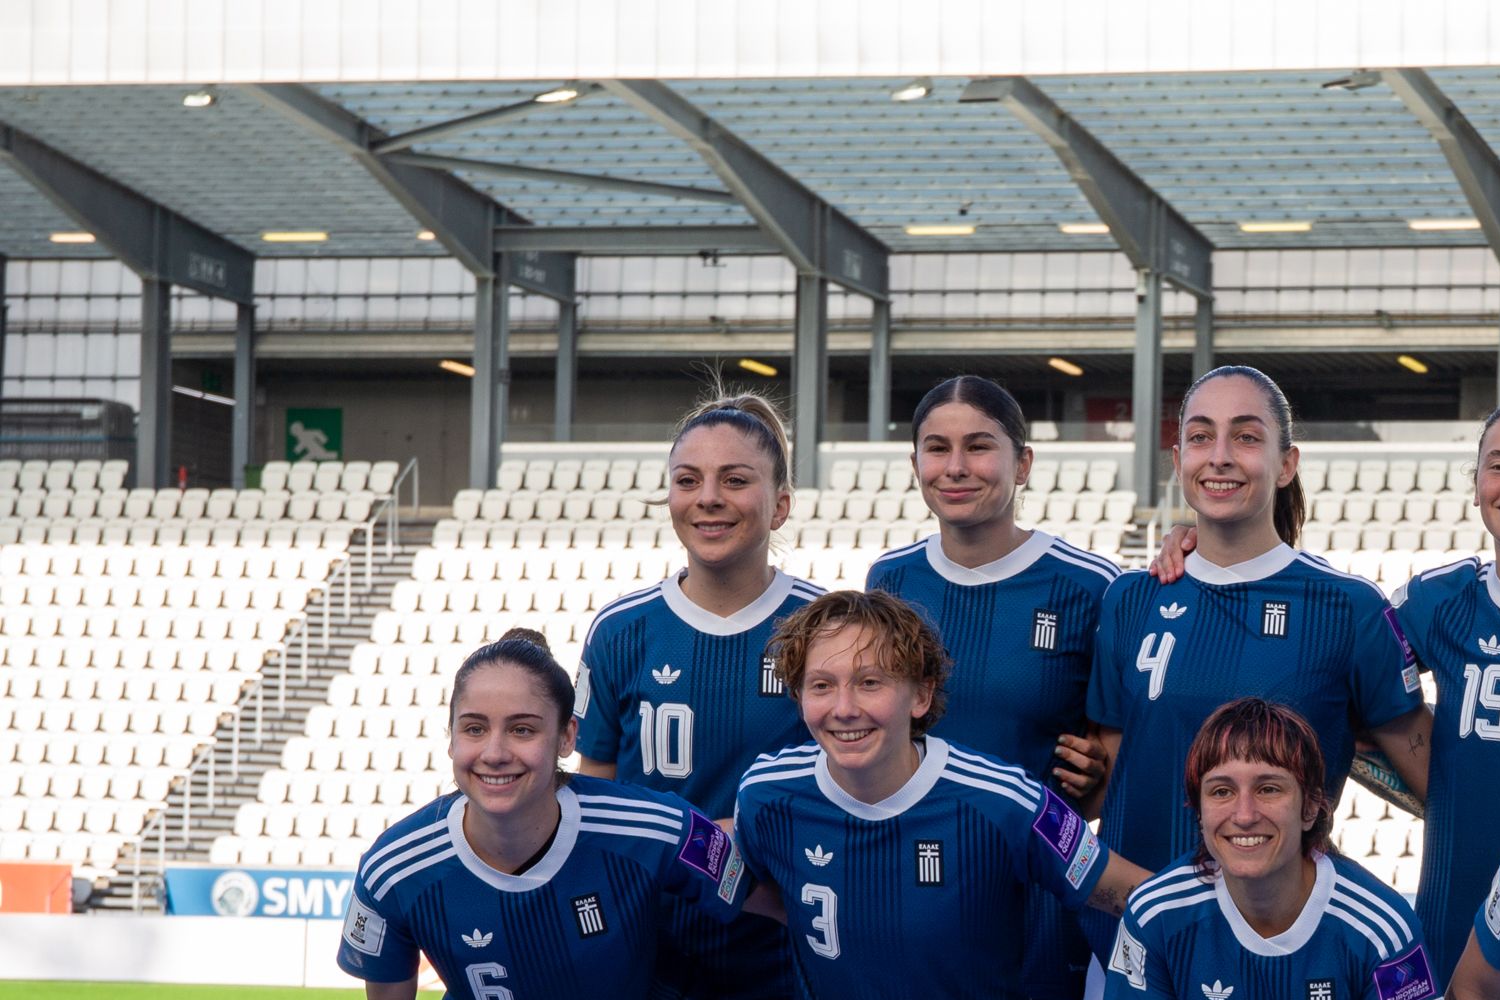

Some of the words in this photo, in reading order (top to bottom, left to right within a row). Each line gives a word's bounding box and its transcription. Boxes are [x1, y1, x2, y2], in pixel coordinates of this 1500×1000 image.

[1136, 631, 1177, 700] 4
[639, 701, 695, 779] 10
[262, 876, 352, 917] SMY
[801, 883, 841, 960] 3
